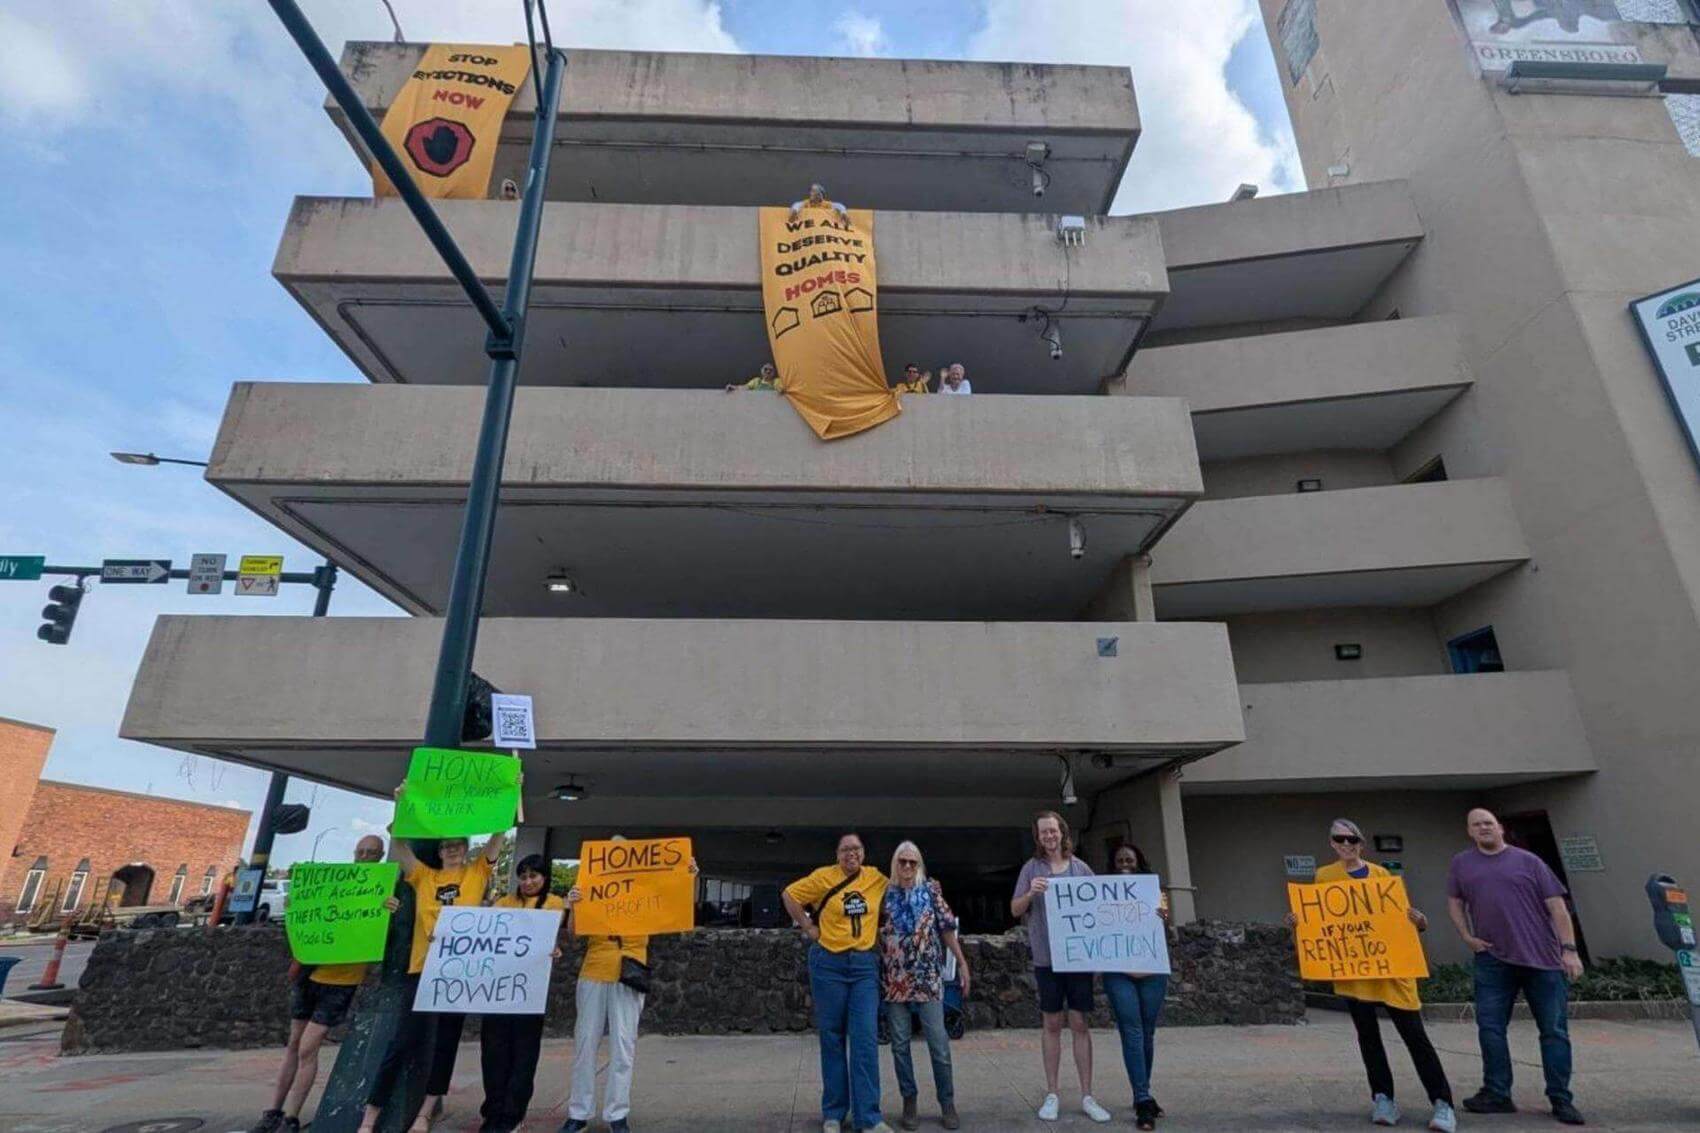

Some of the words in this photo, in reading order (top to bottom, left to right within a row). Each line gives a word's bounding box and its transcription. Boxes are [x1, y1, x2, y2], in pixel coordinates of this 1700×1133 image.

[448, 53, 498, 67] STOP
[1479, 46, 1639, 64] GREENSBORO
[412, 69, 516, 96] EVICTIONS
[432, 89, 486, 110] NOW
[785, 218, 815, 234] WE
[820, 218, 855, 233] ALL
[776, 233, 863, 254] DESERVE
[775, 251, 867, 277] QUALITY
[784, 270, 862, 302] HOMES
[1667, 311, 1700, 330] DAV
[131, 566, 153, 578] WAY
[424, 755, 504, 785] HONK
[588, 840, 682, 874] HOMES
[293, 866, 370, 889] EVICTIONS
[590, 879, 635, 902] NOT
[1055, 881, 1138, 910] HONK
[1298, 881, 1404, 924] HONK
[450, 911, 514, 935] OUR
[1061, 912, 1096, 933] TO
[1097, 900, 1152, 927] STOP
[1321, 924, 1335, 937] IF
[1336, 920, 1376, 936] YOUR
[439, 935, 533, 958] HOMES
[1065, 931, 1158, 963] EVICTION
[1355, 934, 1388, 959] TOO
[440, 957, 496, 980] OUR
[1329, 960, 1391, 978] HIGH
[432, 973, 528, 1006] POWER
